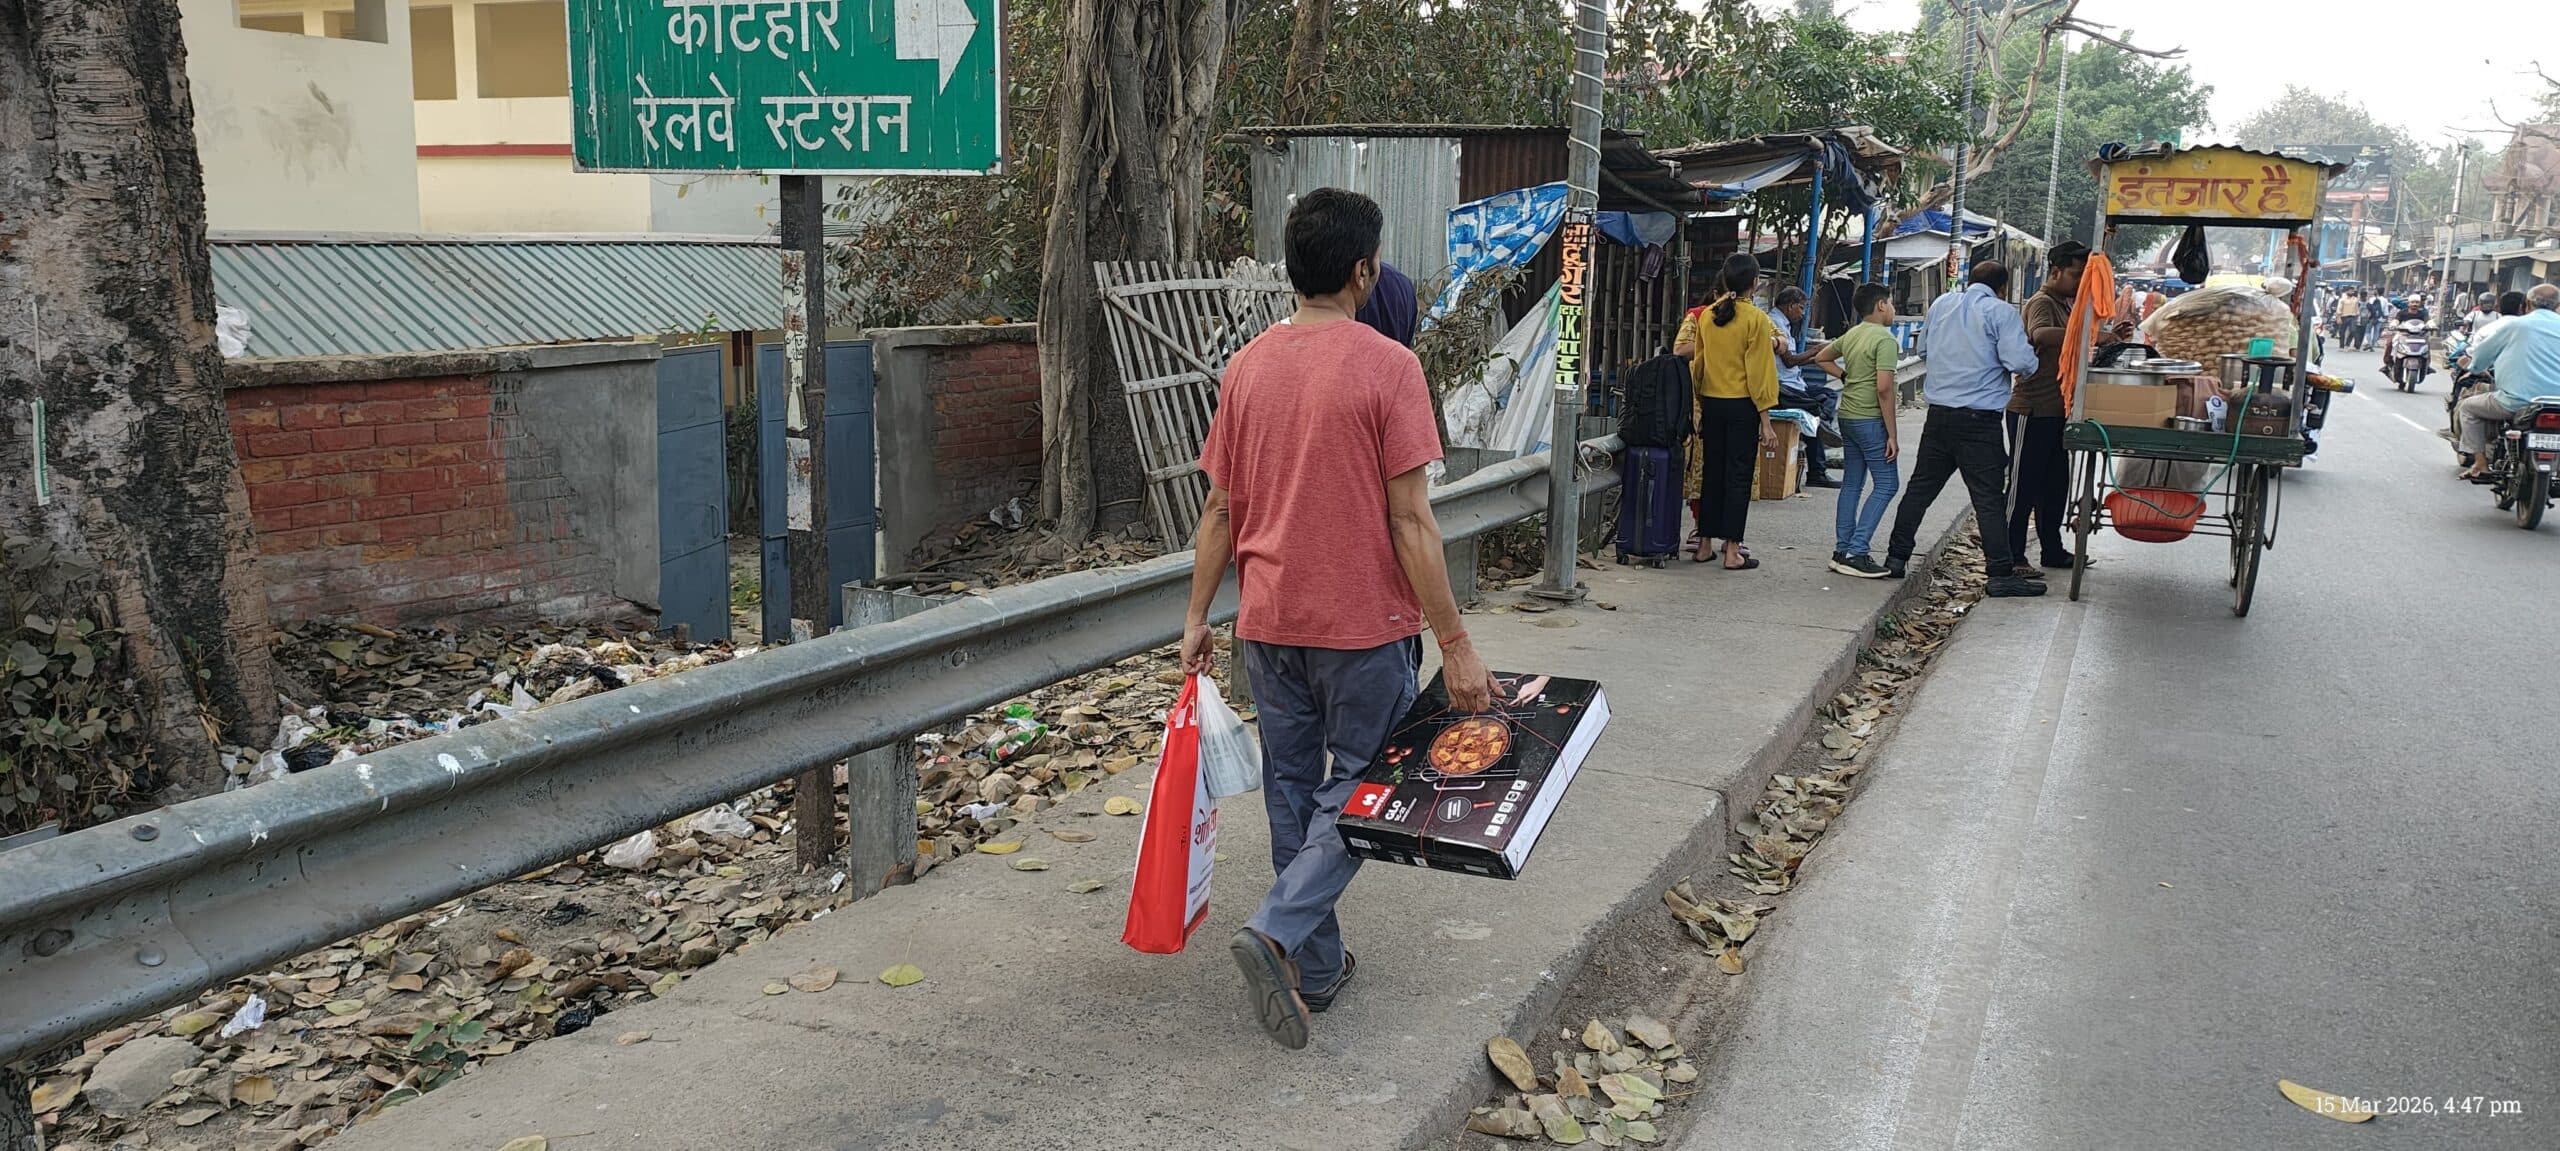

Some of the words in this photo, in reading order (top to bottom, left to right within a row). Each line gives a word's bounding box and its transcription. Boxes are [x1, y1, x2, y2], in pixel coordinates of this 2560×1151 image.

[633, 72, 735, 152] रेलवे
[761, 70, 912, 152] स्टेशन
[2117, 167, 2254, 214] इंतजार
[2257, 164, 2291, 214] है
[1369, 787, 1391, 816] HAVELLS
[1385, 800, 1402, 820] GLO
